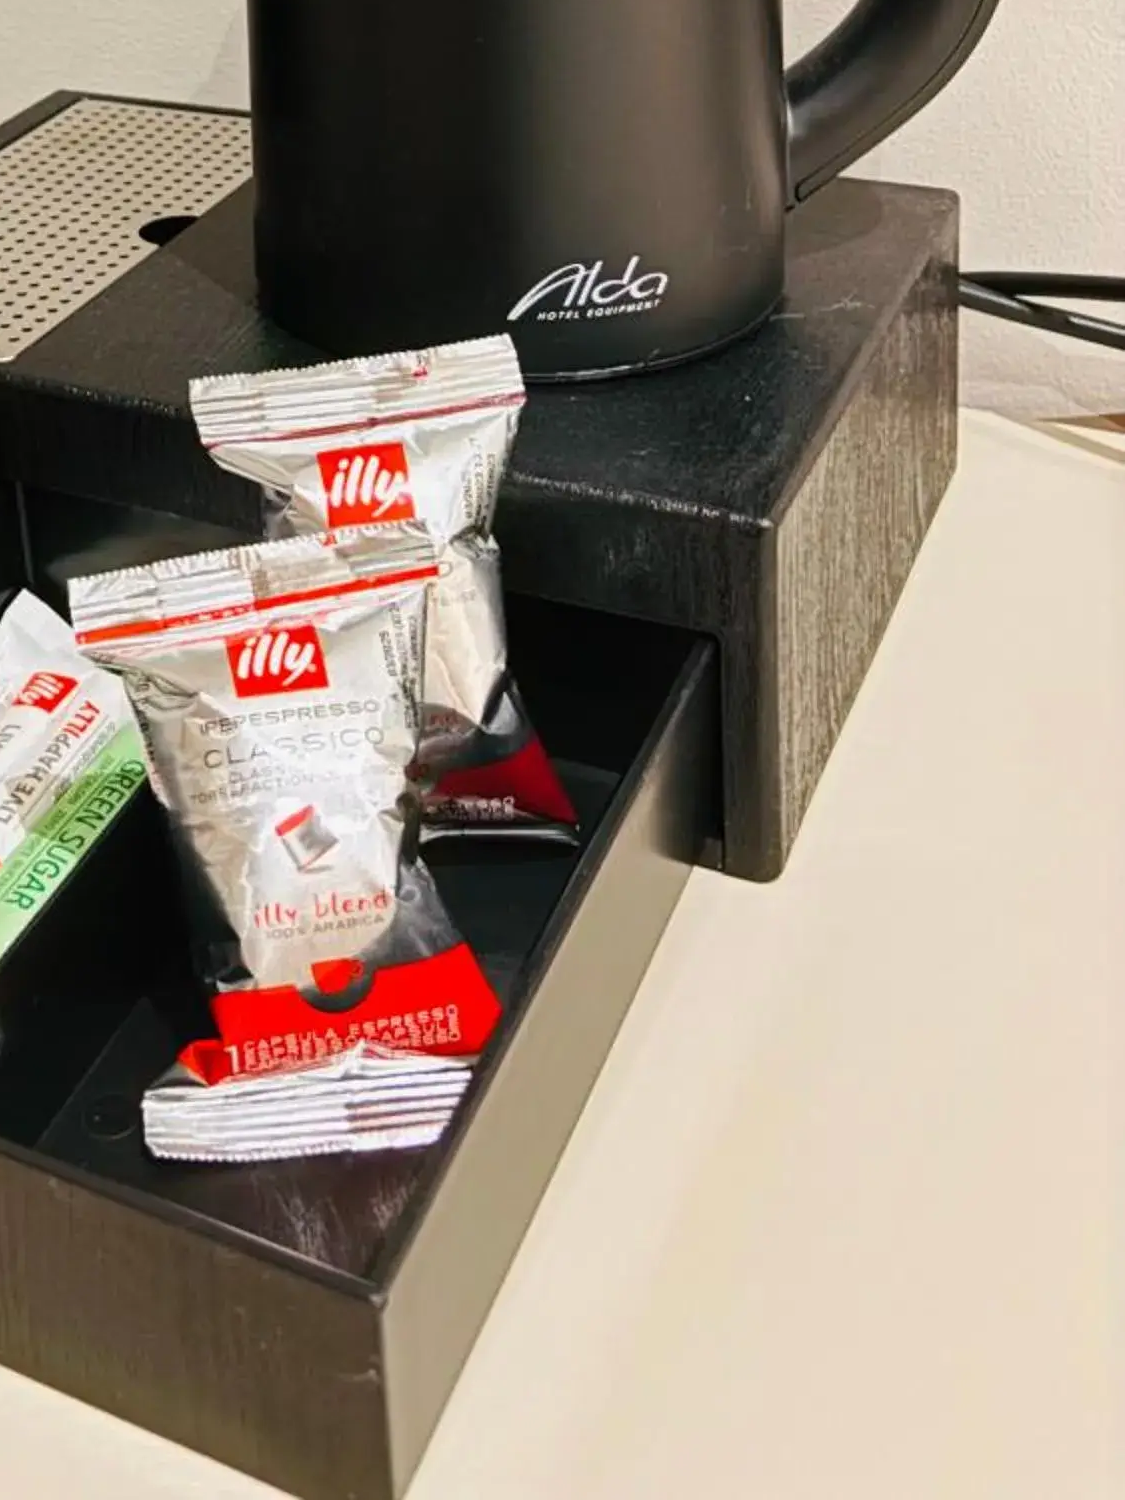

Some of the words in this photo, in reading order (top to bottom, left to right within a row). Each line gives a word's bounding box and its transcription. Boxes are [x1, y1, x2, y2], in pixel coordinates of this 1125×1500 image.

[507, 255, 669, 321] Alda
[536, 310, 580, 321] HOTEL
[586, 299, 662, 319] EQUIPMENT
[330, 455, 406, 518] illy
[236, 631, 316, 687] illy
[33, 699, 102, 783] HAPPILLY
[204, 725, 384, 769] CLASSICO
[75, 759, 146, 831] GREEN
[2, 829, 86, 911] SUGAR
[254, 901, 298, 929] illy
[312, 887, 390, 918] blend
[313, 914, 385, 933] ARABICA
